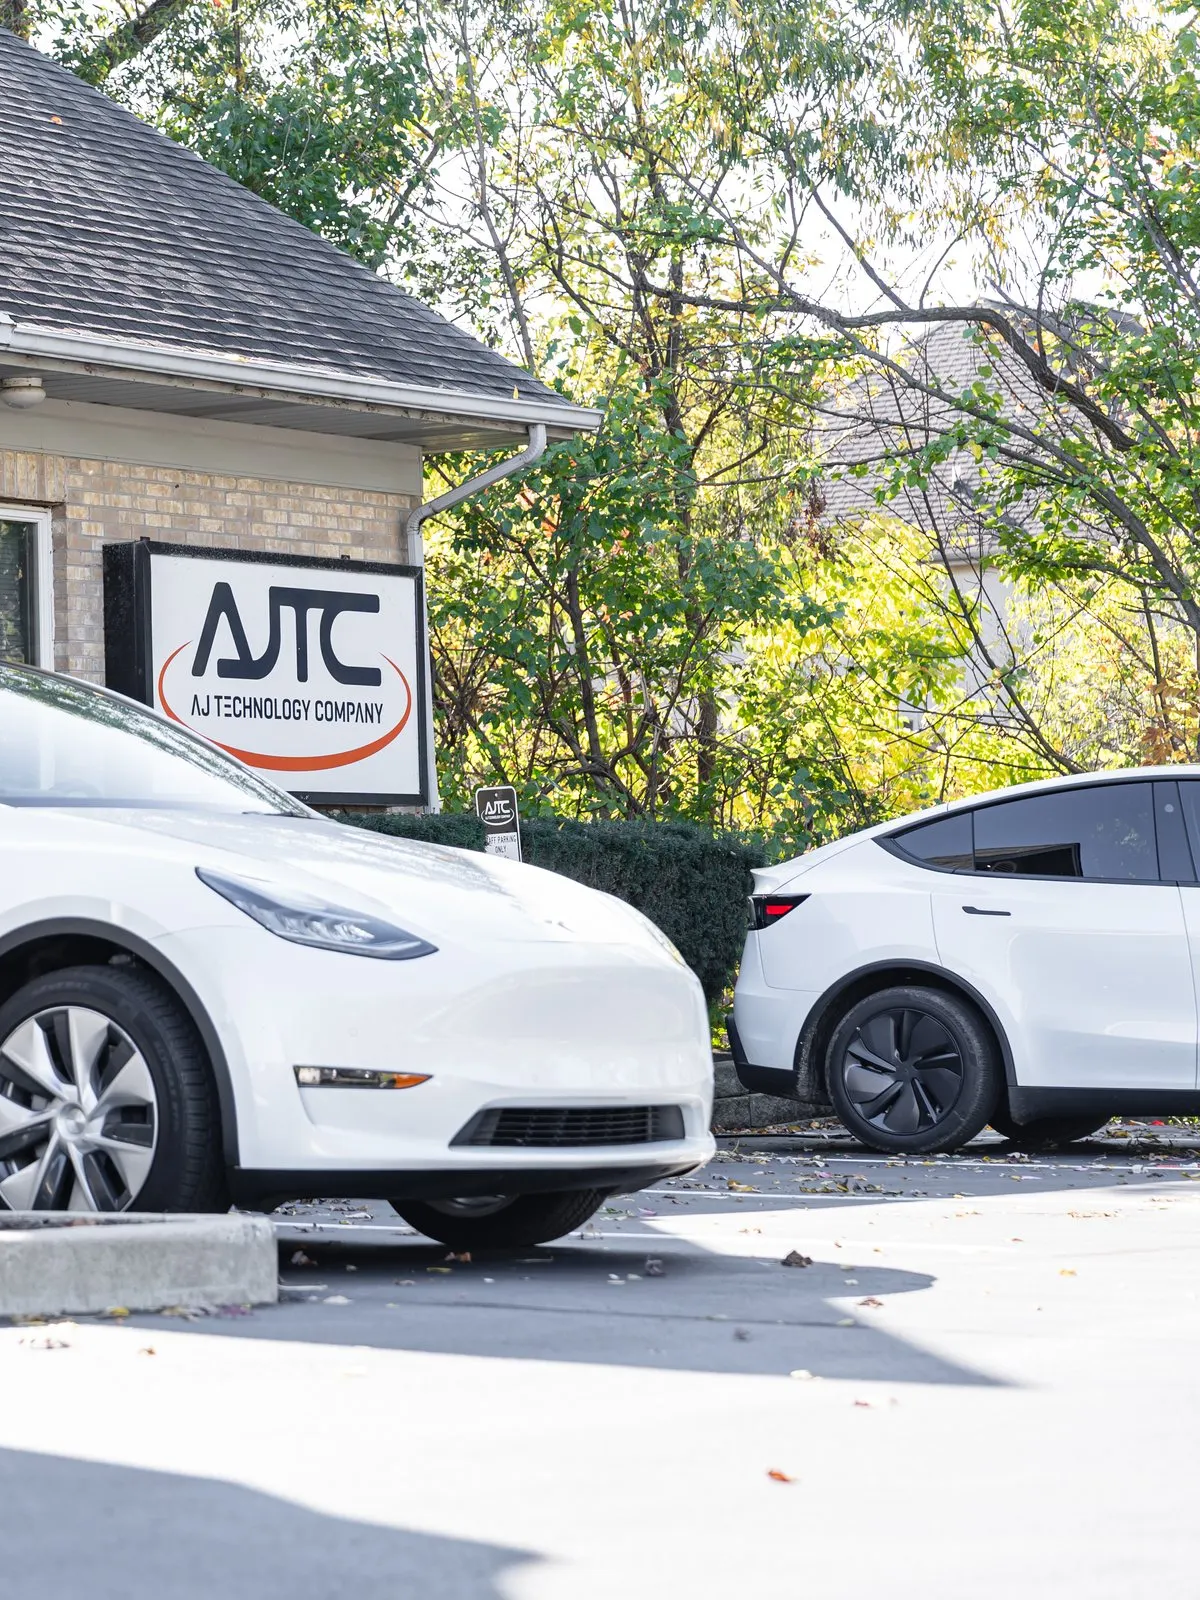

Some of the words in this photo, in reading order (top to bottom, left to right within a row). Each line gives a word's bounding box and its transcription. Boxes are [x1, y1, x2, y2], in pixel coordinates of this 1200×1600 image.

[191, 581, 382, 687] AJTC
[191, 694, 210, 717] AJ
[214, 695, 311, 721] TECHNOLOGY
[315, 700, 384, 724] COMPANY
[485, 800, 510, 815] AJTC
[495, 845, 507, 854] ONLY
